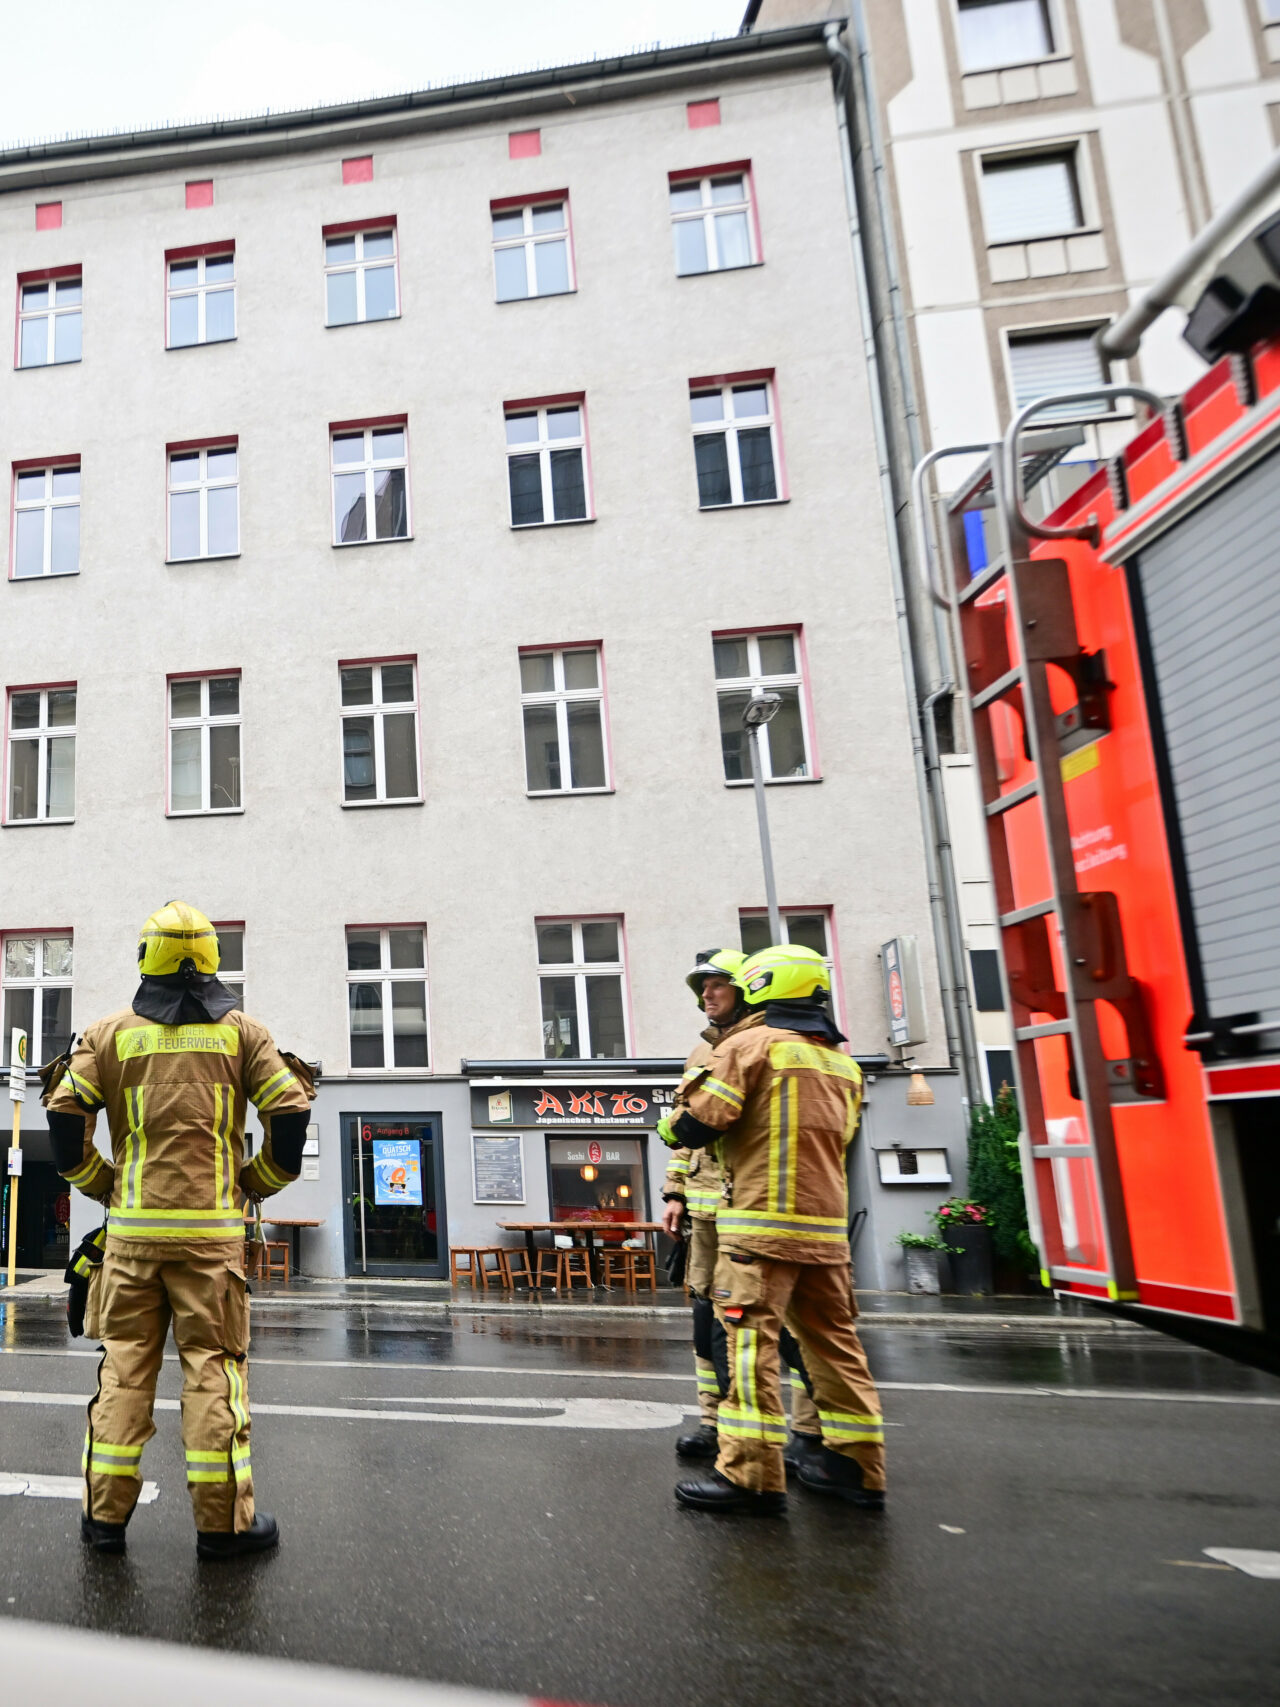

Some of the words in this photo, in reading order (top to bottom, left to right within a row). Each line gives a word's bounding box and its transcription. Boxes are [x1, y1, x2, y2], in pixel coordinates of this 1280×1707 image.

[157, 1026, 205, 1037] BERLINER
[157, 1037, 226, 1050] FEUERWEHR
[535, 1117, 591, 1125] Japanisches
[362, 1125, 372, 1141] 6
[382, 1144, 411, 1154] QUATSCH
[567, 1151, 585, 1161] Sushi
[606, 1151, 620, 1161] BAR
